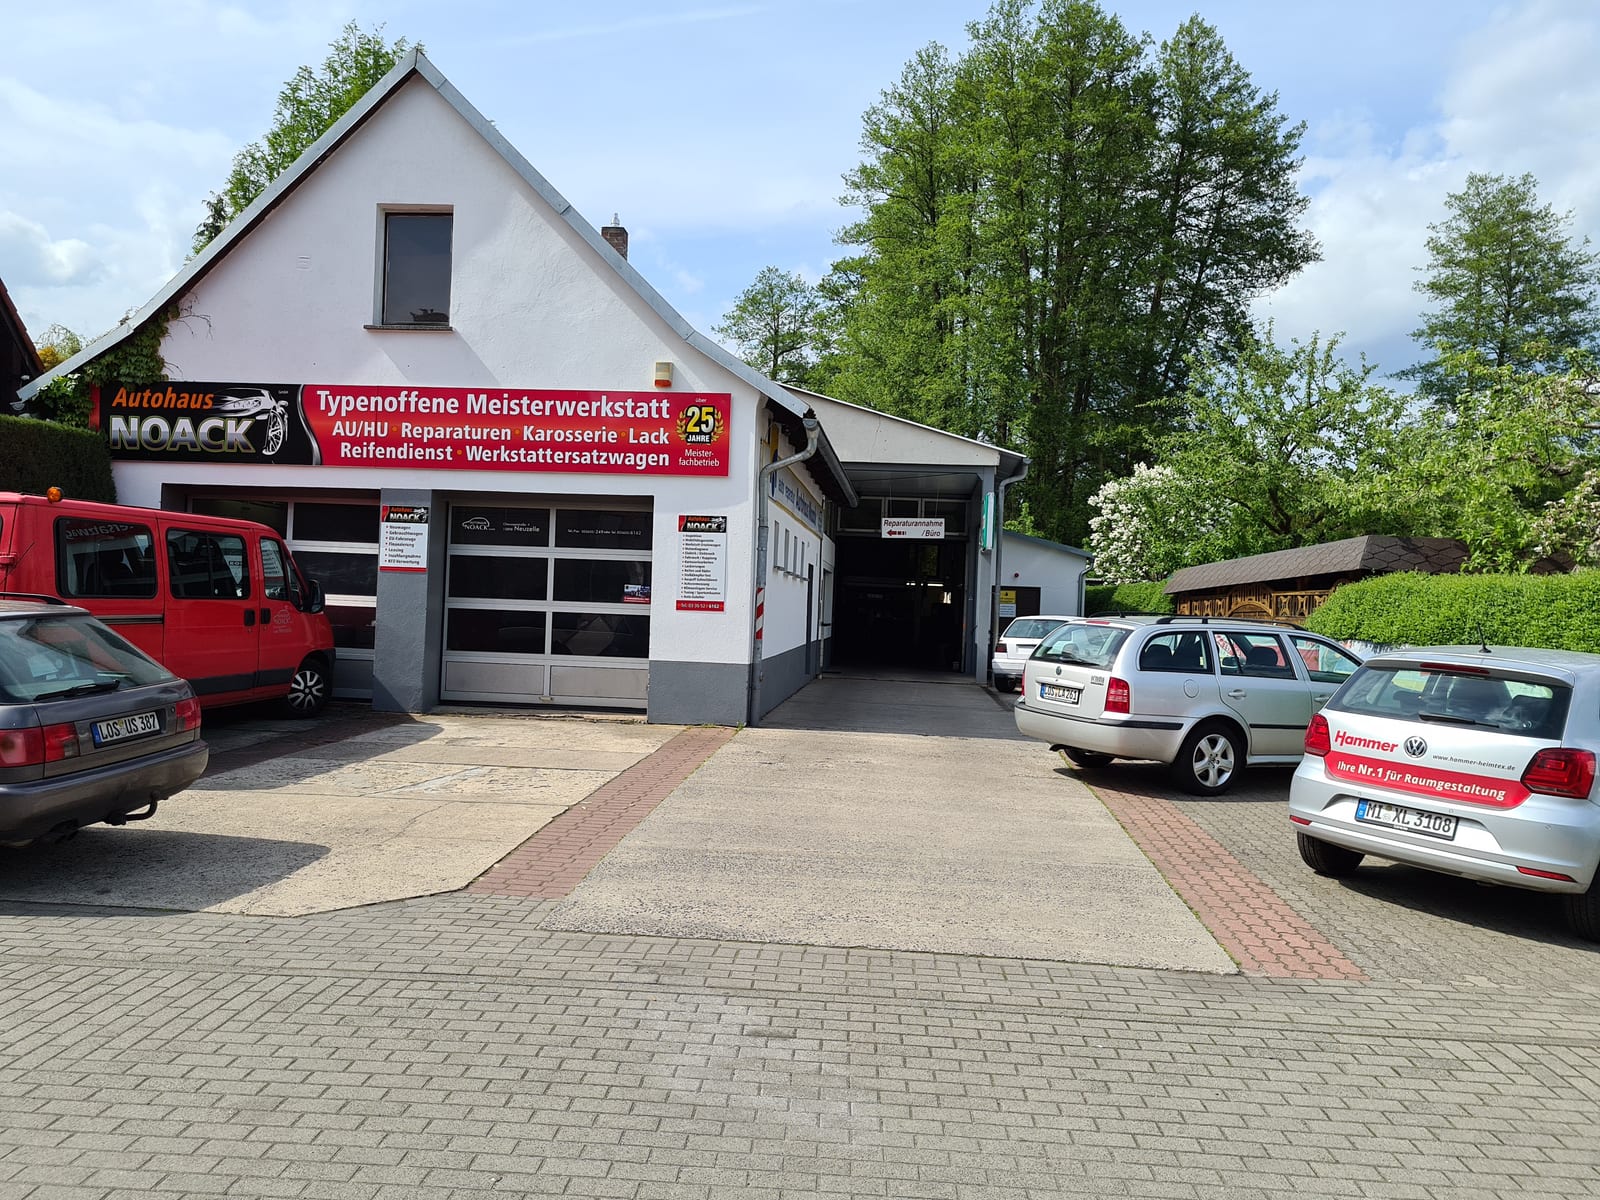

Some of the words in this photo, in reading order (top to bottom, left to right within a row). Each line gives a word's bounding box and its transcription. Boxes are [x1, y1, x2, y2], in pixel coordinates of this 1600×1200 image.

[112, 387, 215, 409] Autohaus
[317, 390, 459, 416] Typenoffene
[467, 394, 670, 418] Meisterwerkstatt
[686, 406, 714, 433] 25
[110, 416, 255, 452] NOACK
[332, 421, 388, 438] AU/HU
[401, 423, 511, 442] Reparaturen
[523, 426, 617, 443] Karosserie
[629, 427, 669, 444] Lack
[687, 434, 710, 442] JAHRE
[340, 442, 452, 461] Reifendienst
[466, 446, 669, 469] Werkstattersatzwagen
[678, 457, 720, 467] fachbetrieb
[684, 449, 714, 457] Meister-
[389, 513, 420, 521] NOACK
[686, 522, 718, 530] NOACK
[884, 519, 943, 528] Reparaturannahme
[99, 721, 121, 740] LOS
[124, 718, 138, 734] US
[139, 714, 156, 731] 387
[1334, 730, 1398, 753] Hammer
[1432, 754, 1516, 771] www.hammer-heimtex.de
[1337, 760, 1356, 774] Ihre
[1384, 770, 1402, 783] für
[1404, 775, 1506, 800] Raumgestaltung
[1366, 802, 1383, 819] MI
[1392, 808, 1410, 825] XL
[1414, 812, 1452, 833] 3108
